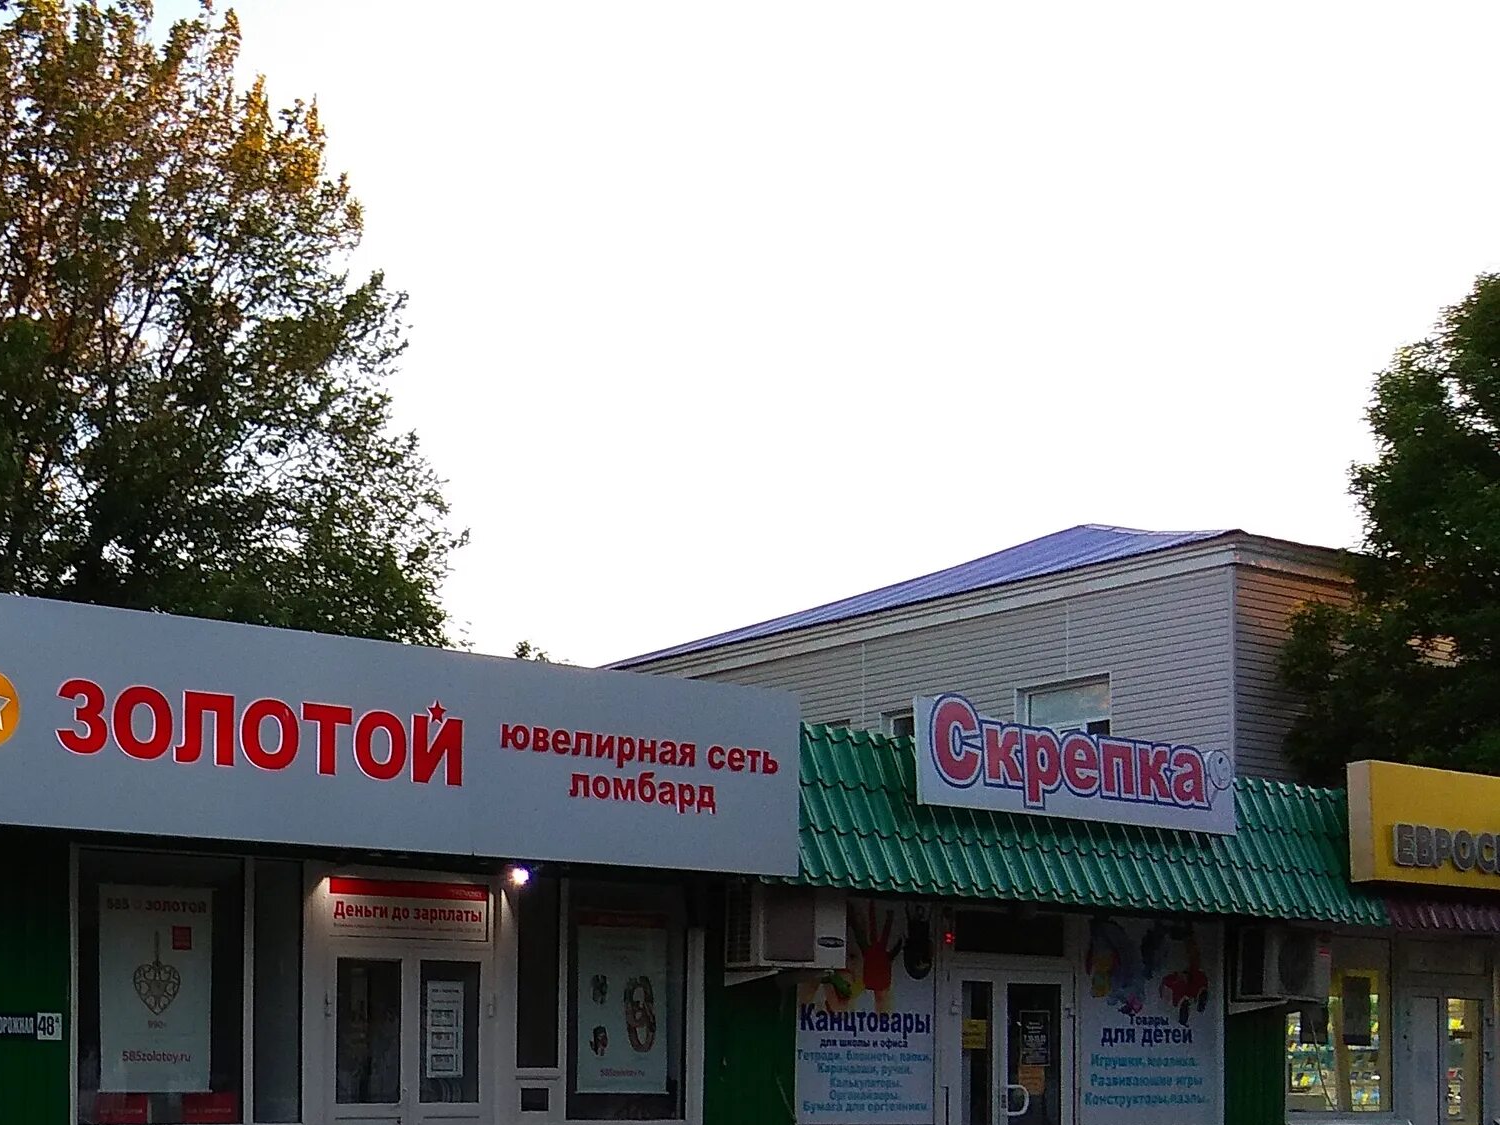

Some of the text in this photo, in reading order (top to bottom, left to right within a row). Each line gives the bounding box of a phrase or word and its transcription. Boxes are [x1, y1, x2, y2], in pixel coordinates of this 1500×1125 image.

[55, 678, 465, 787] ЗОЛОТОЙ
[501, 723, 779, 775] ювелирная сеть
[930, 693, 1212, 811] Скрепка
[570, 772, 716, 814] ломбард
[1394, 823, 1500, 874] ЕВРОС
[334, 901, 482, 923] Деньги до зарплаты
[800, 1003, 931, 1039] Канцтовары
[1101, 1027, 1192, 1047] для детей
[1129, 1013, 1169, 1027] Товары
[122, 1051, 191, 1064] 585zolotoy.ru
[820, 1037, 908, 1049] для школы и офиса
